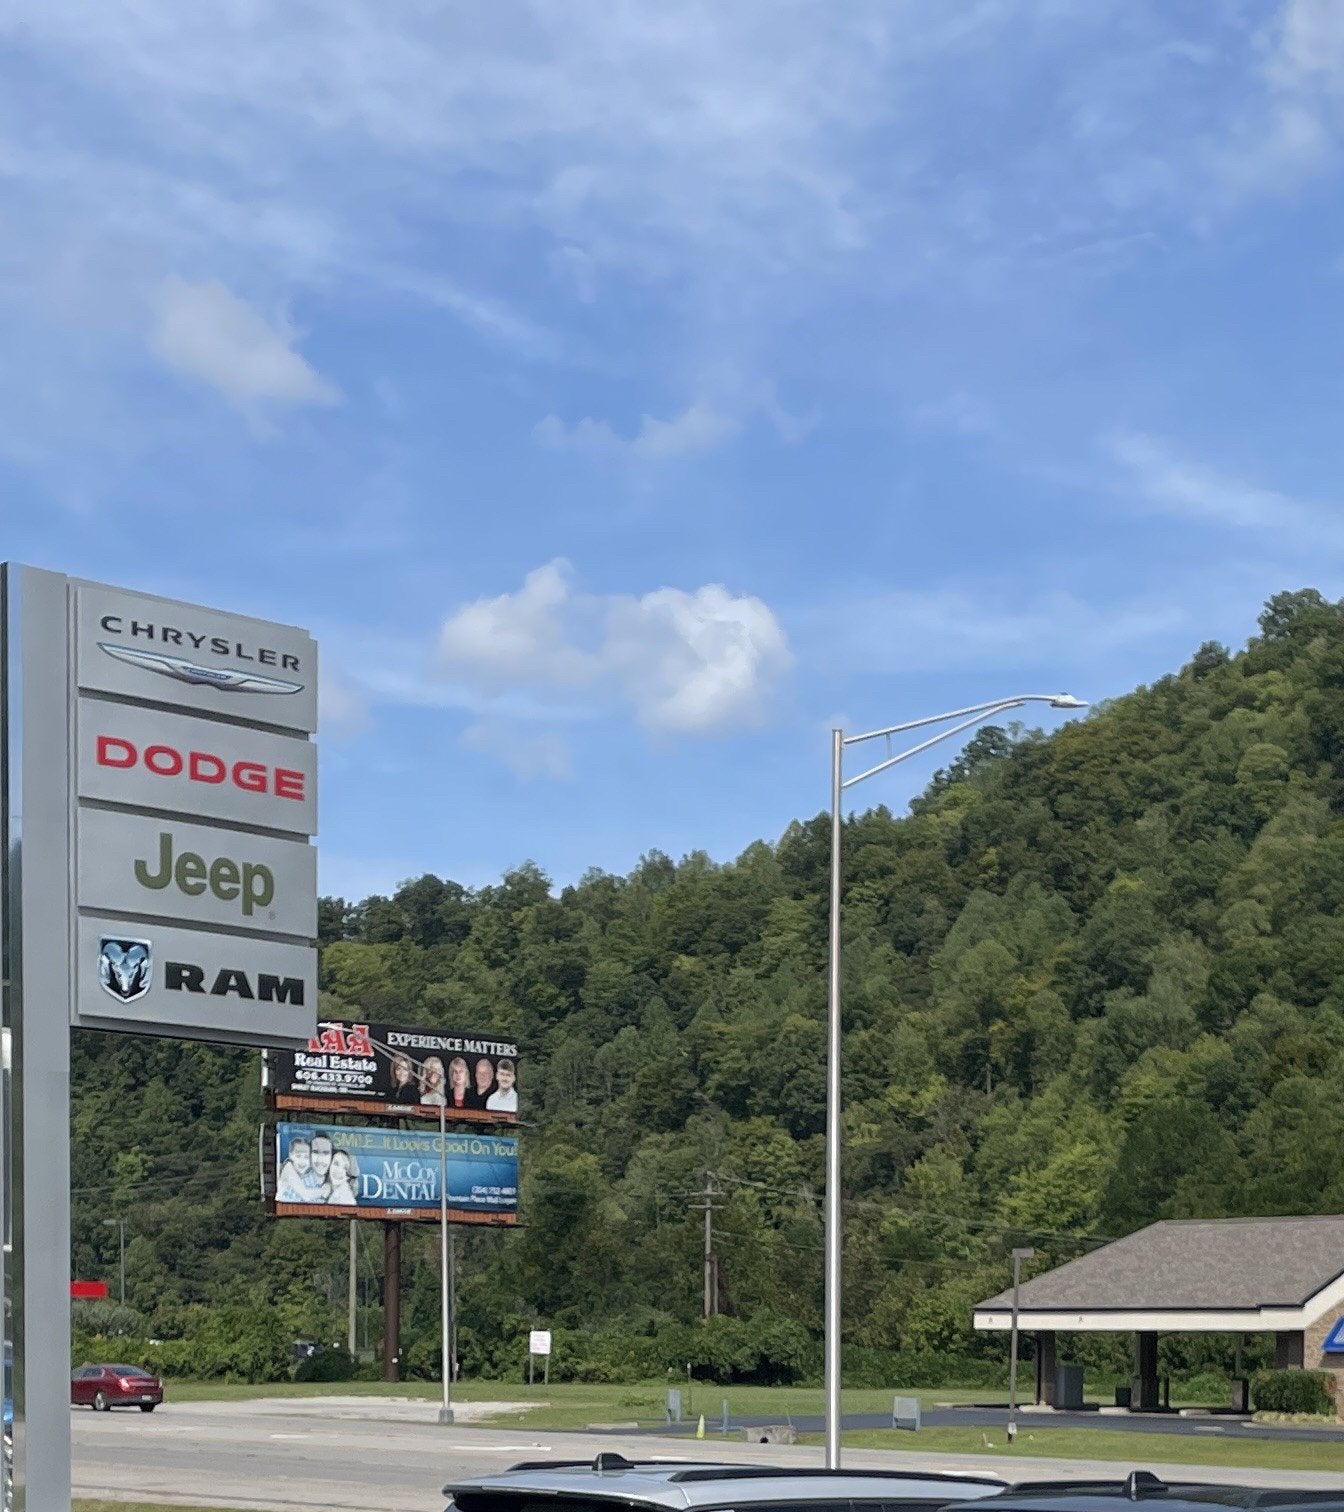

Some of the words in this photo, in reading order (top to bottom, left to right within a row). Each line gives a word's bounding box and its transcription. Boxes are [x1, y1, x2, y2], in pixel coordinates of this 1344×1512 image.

[100, 615, 301, 672] CHRYSLER
[96, 735, 305, 801] DODGE
[134, 832, 275, 916] Jeep
[165, 961, 305, 1006] RAM
[387, 1031, 462, 1052] EXPERIENCE
[463, 1039, 517, 1057] MATTERS
[294, 1052, 327, 1068] Real
[329, 1055, 377, 1073] Estate
[470, 1139, 490, 1155] On
[361, 1173, 442, 1200] DENTAL
